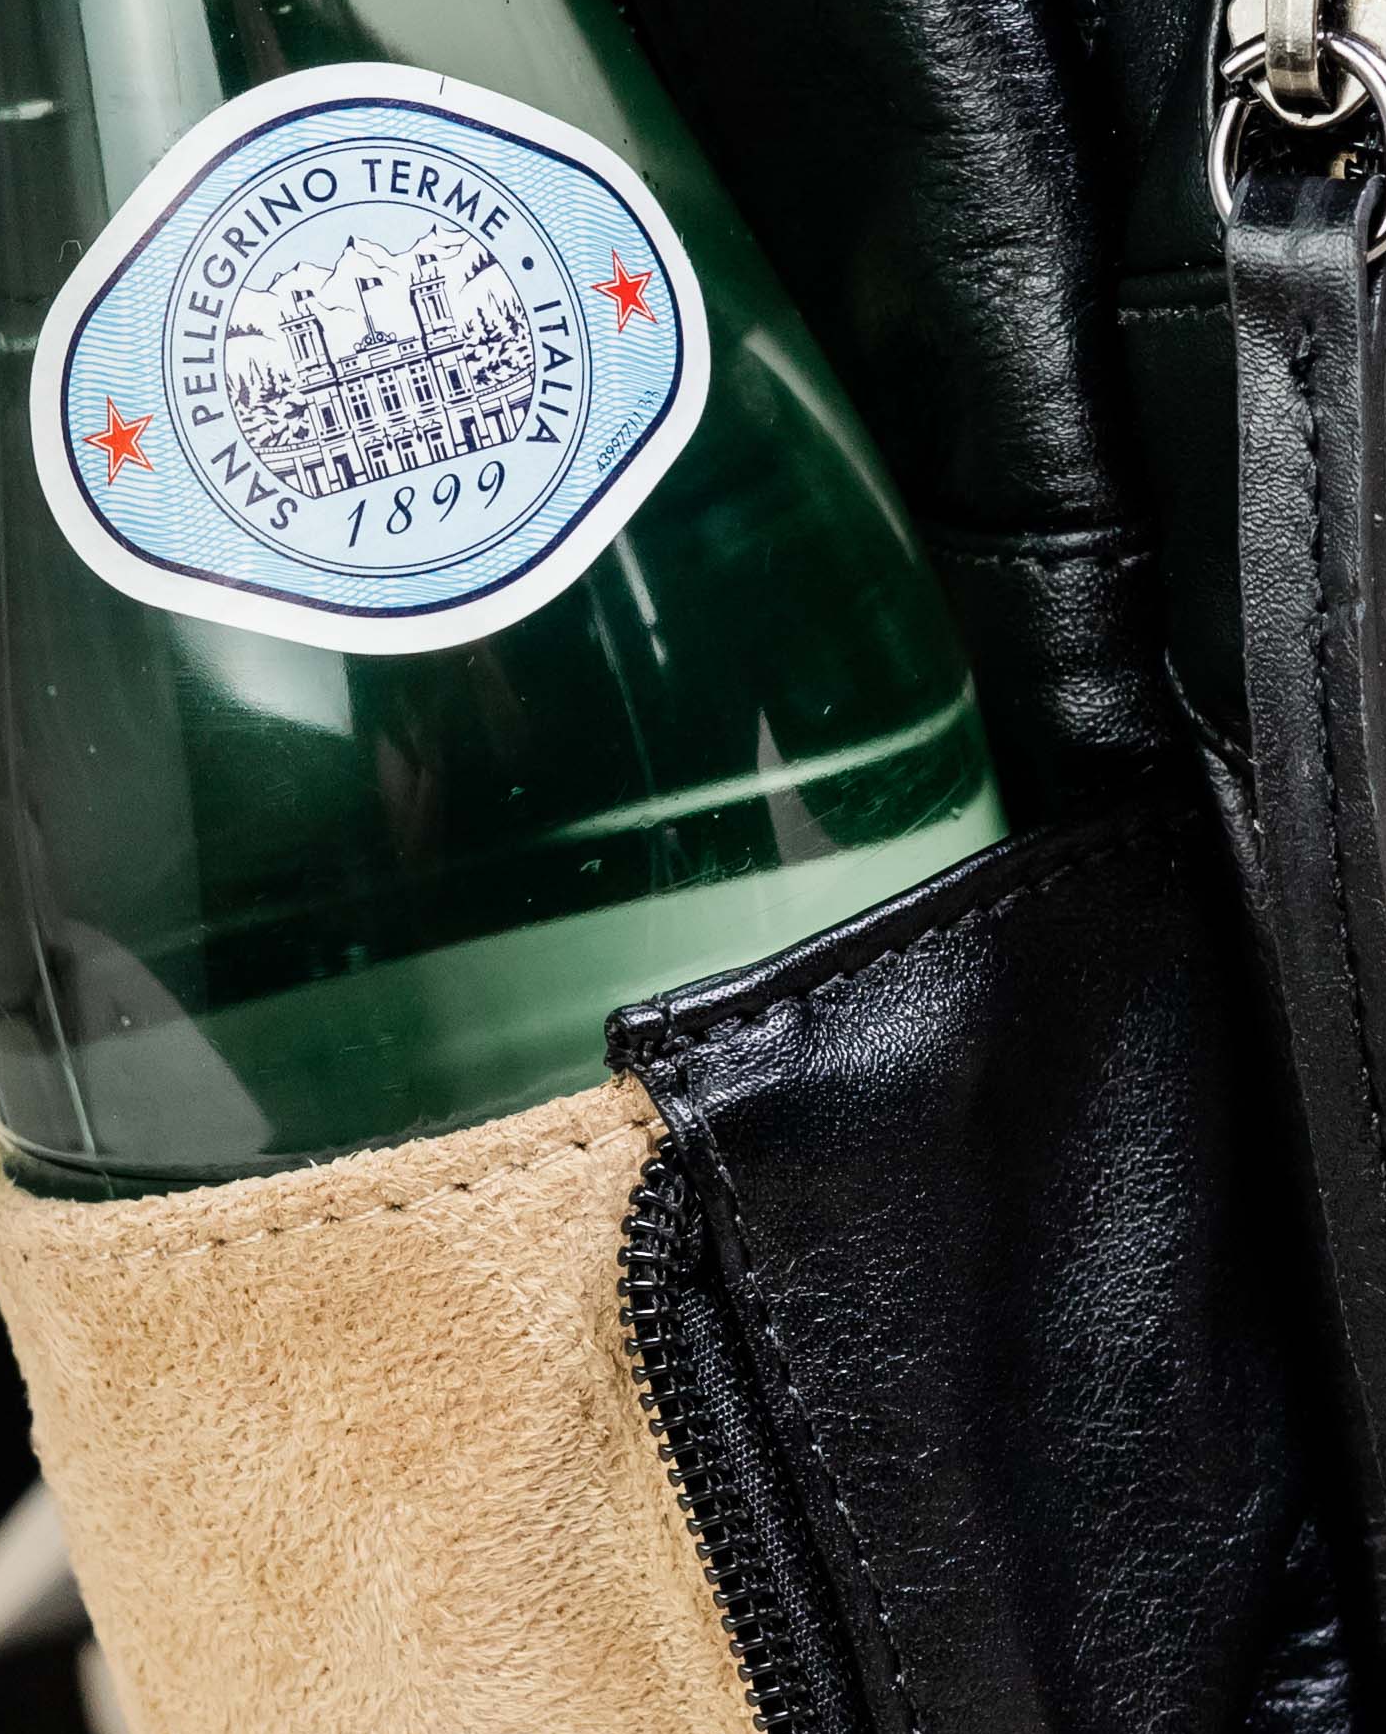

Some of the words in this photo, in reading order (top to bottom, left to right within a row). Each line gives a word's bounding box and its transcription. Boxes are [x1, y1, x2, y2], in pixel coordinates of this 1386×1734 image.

[361, 158, 510, 240] TERME
[183, 167, 338, 429] PELLEGRINO
[525, 299, 574, 445] ITALIA
[210, 441, 298, 531] SAN
[347, 460, 506, 547] 1899
